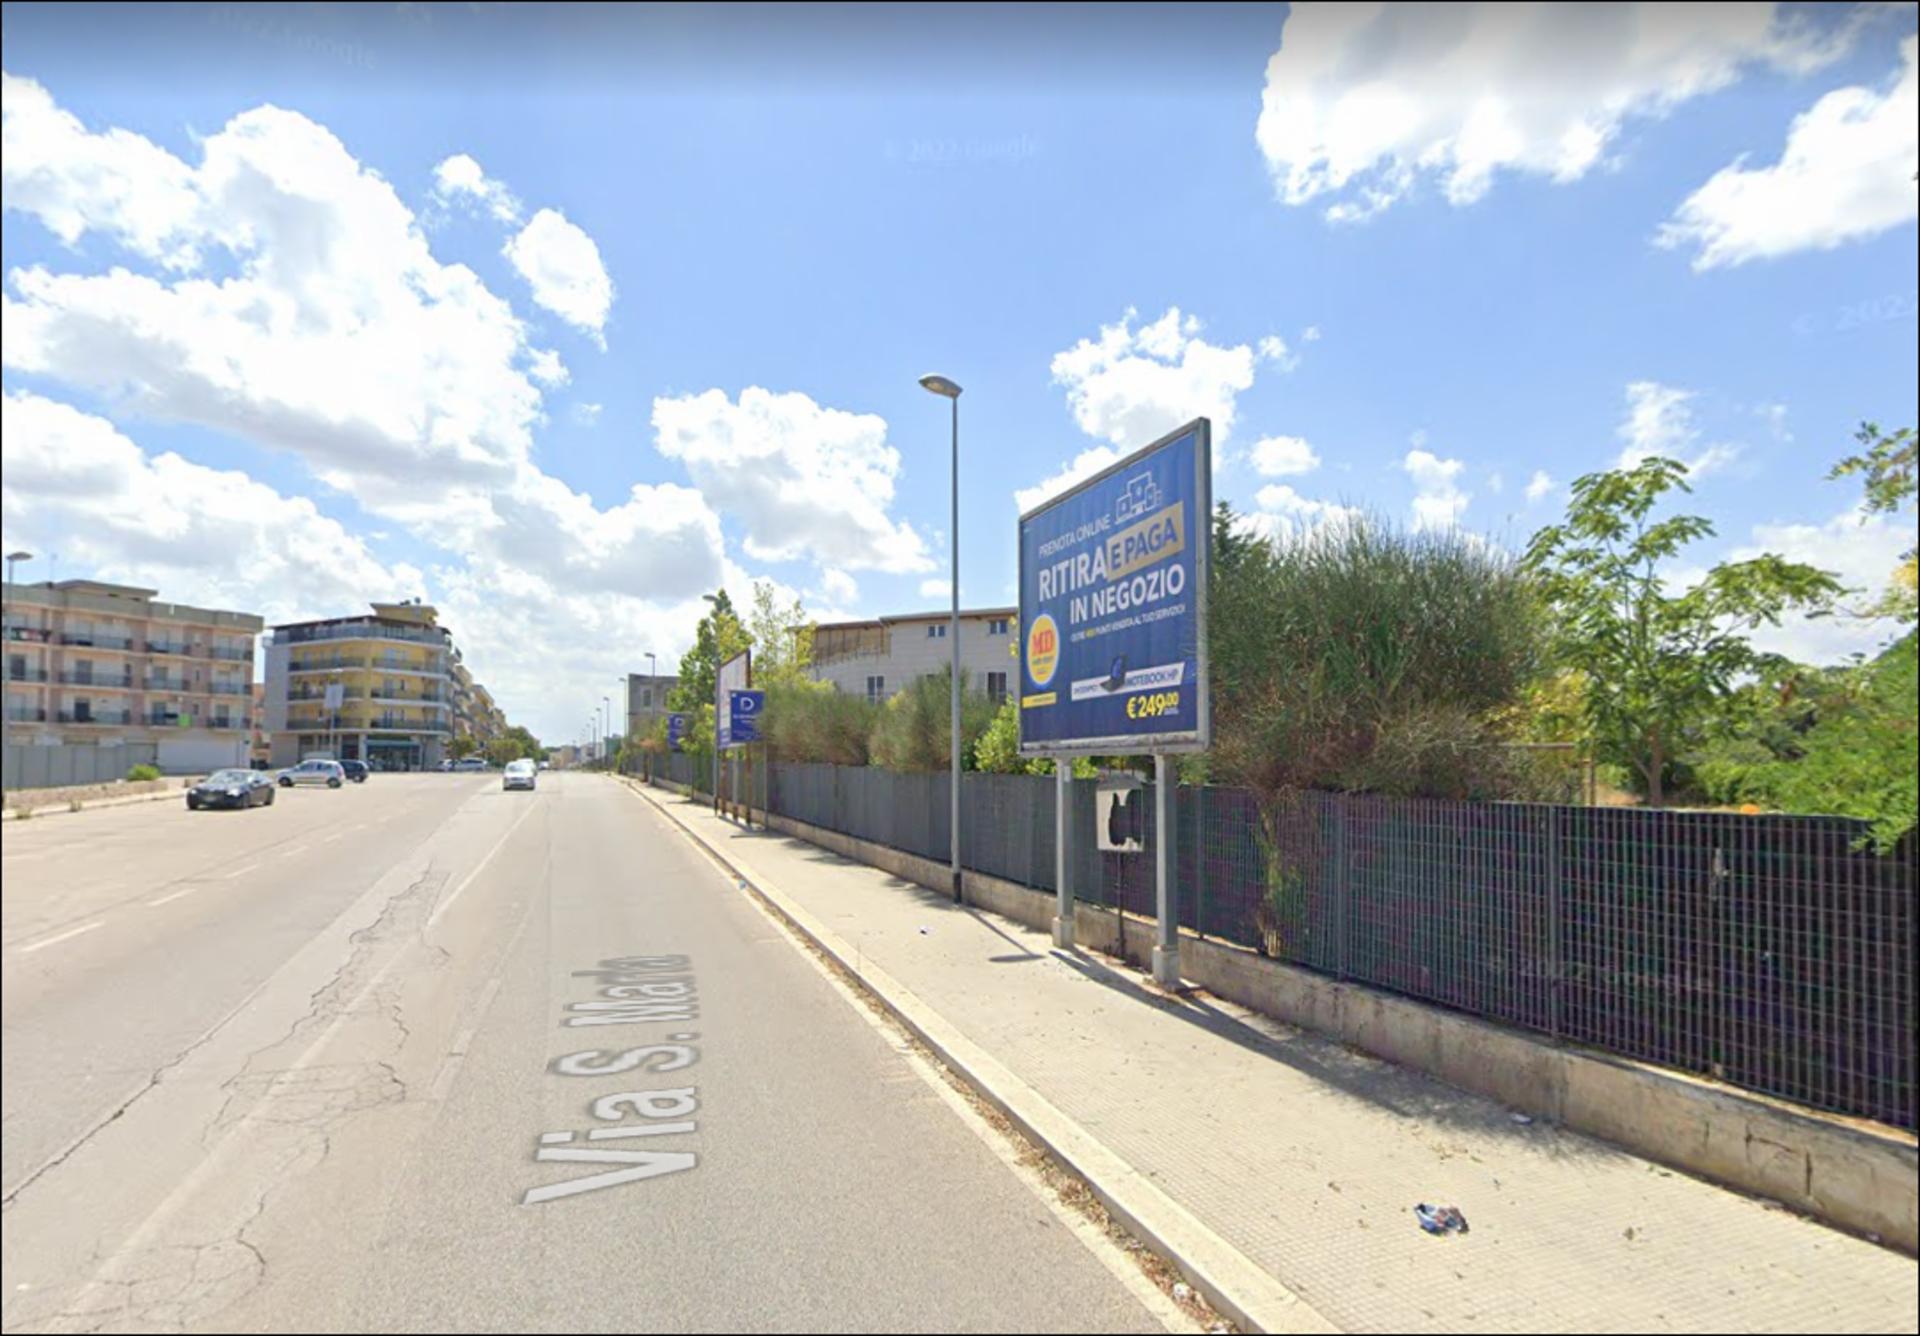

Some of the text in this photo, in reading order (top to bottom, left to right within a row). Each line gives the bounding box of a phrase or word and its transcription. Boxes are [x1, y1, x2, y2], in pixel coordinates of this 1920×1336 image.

[1039, 513, 1111, 559] PRENOTA ONLINE
[1039, 517, 1178, 602] RITIRA E PAGA
[1070, 563, 1185, 625] IN NEGOZIO
